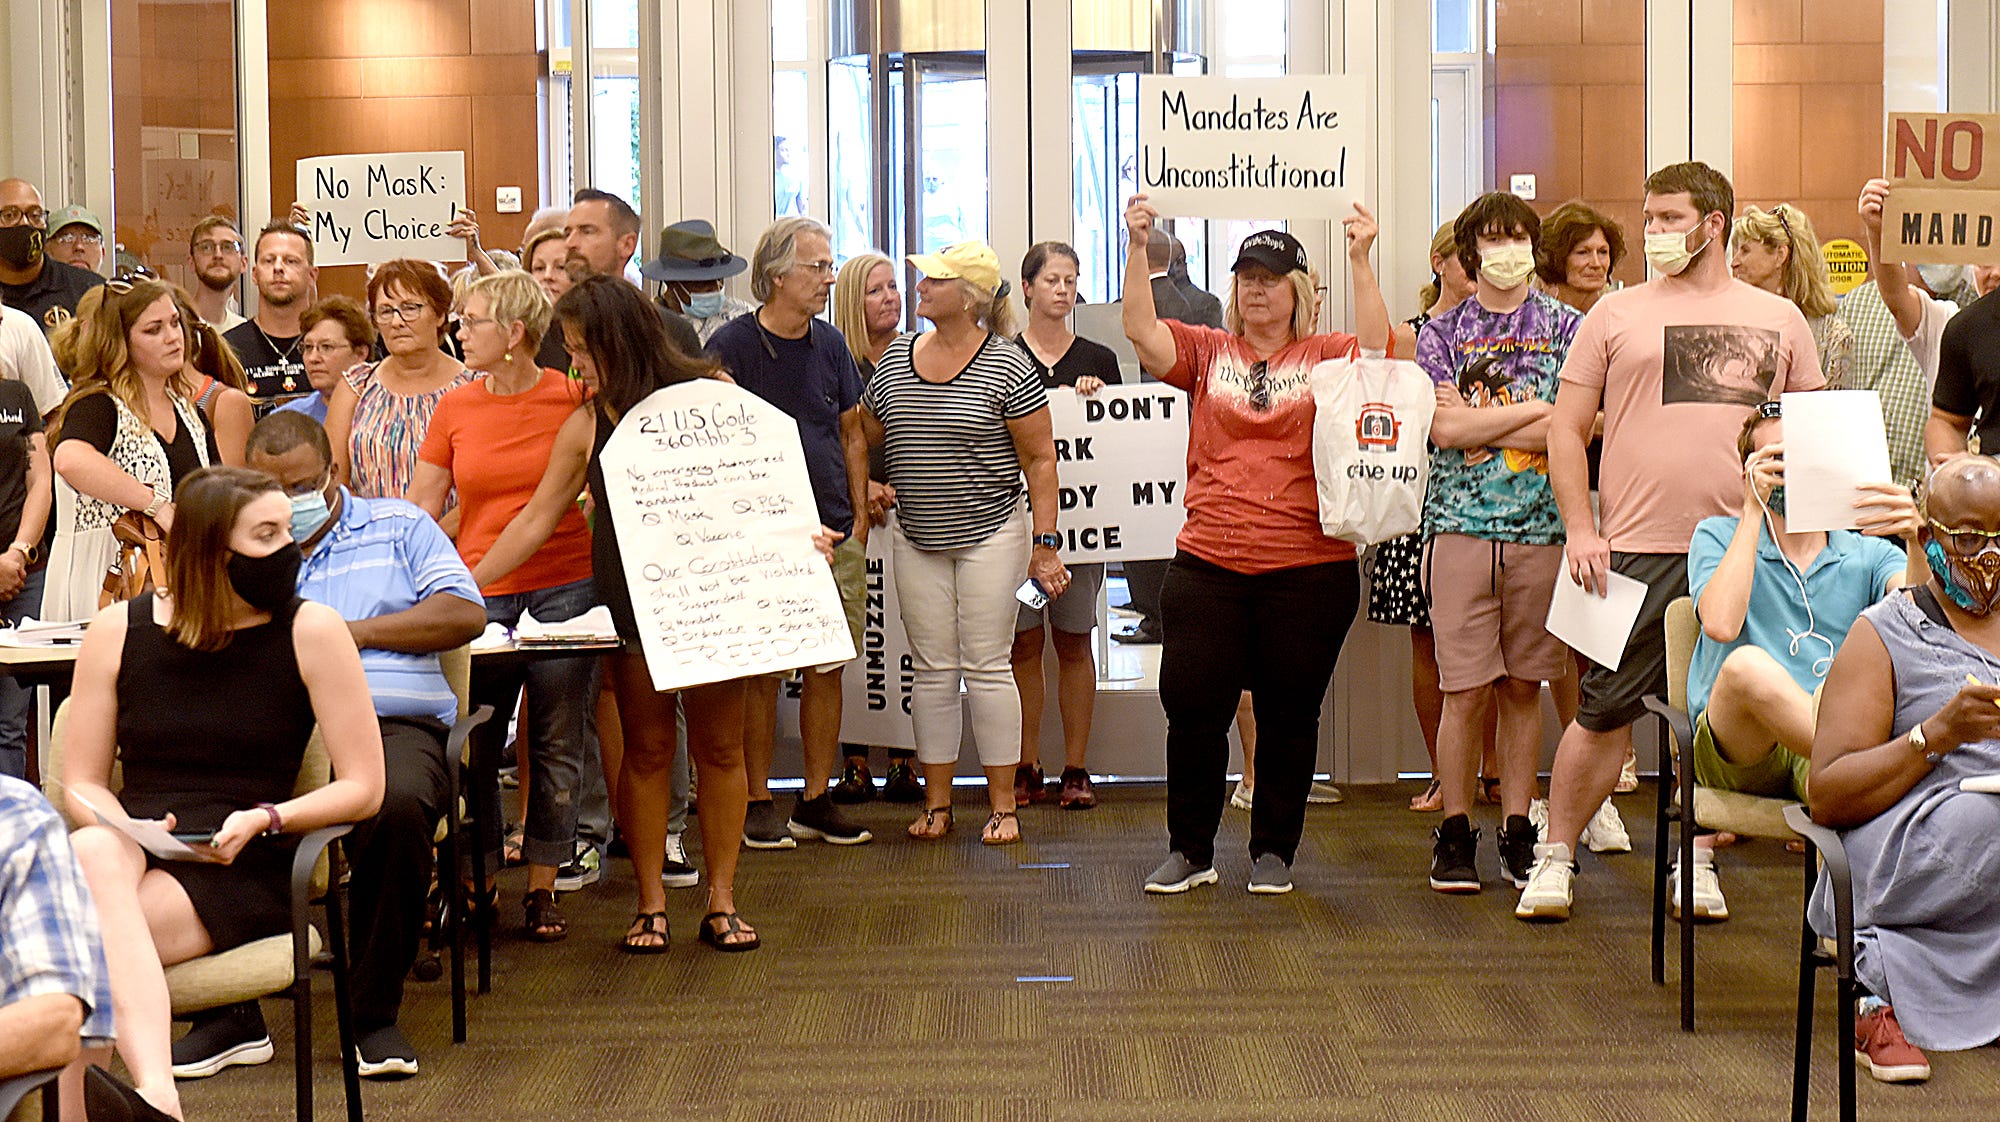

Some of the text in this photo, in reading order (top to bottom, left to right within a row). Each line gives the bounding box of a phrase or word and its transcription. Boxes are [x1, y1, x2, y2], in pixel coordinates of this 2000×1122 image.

[1162, 89, 1339, 131] Mandates Are
[1894, 118, 1983, 181] NO
[316, 166, 349, 199] No
[1144, 144, 1346, 190] Unconstitutional
[315, 210, 351, 254] My
[1901, 212, 1993, 248] MAND
[1822, 251, 1864, 259] UTOMATIC
[1829, 262, 1866, 273] UTION
[639, 402, 758, 434] 21 US Code
[1086, 395, 1176, 423] DON'T
[626, 464, 646, 482] No
[1392, 465, 1418, 484] up
[1131, 481, 1177, 506] MY
[642, 563, 681, 582] Our
[672, 628, 846, 668] FREEDOM
[866, 558, 886, 711] UNMUZZLE
